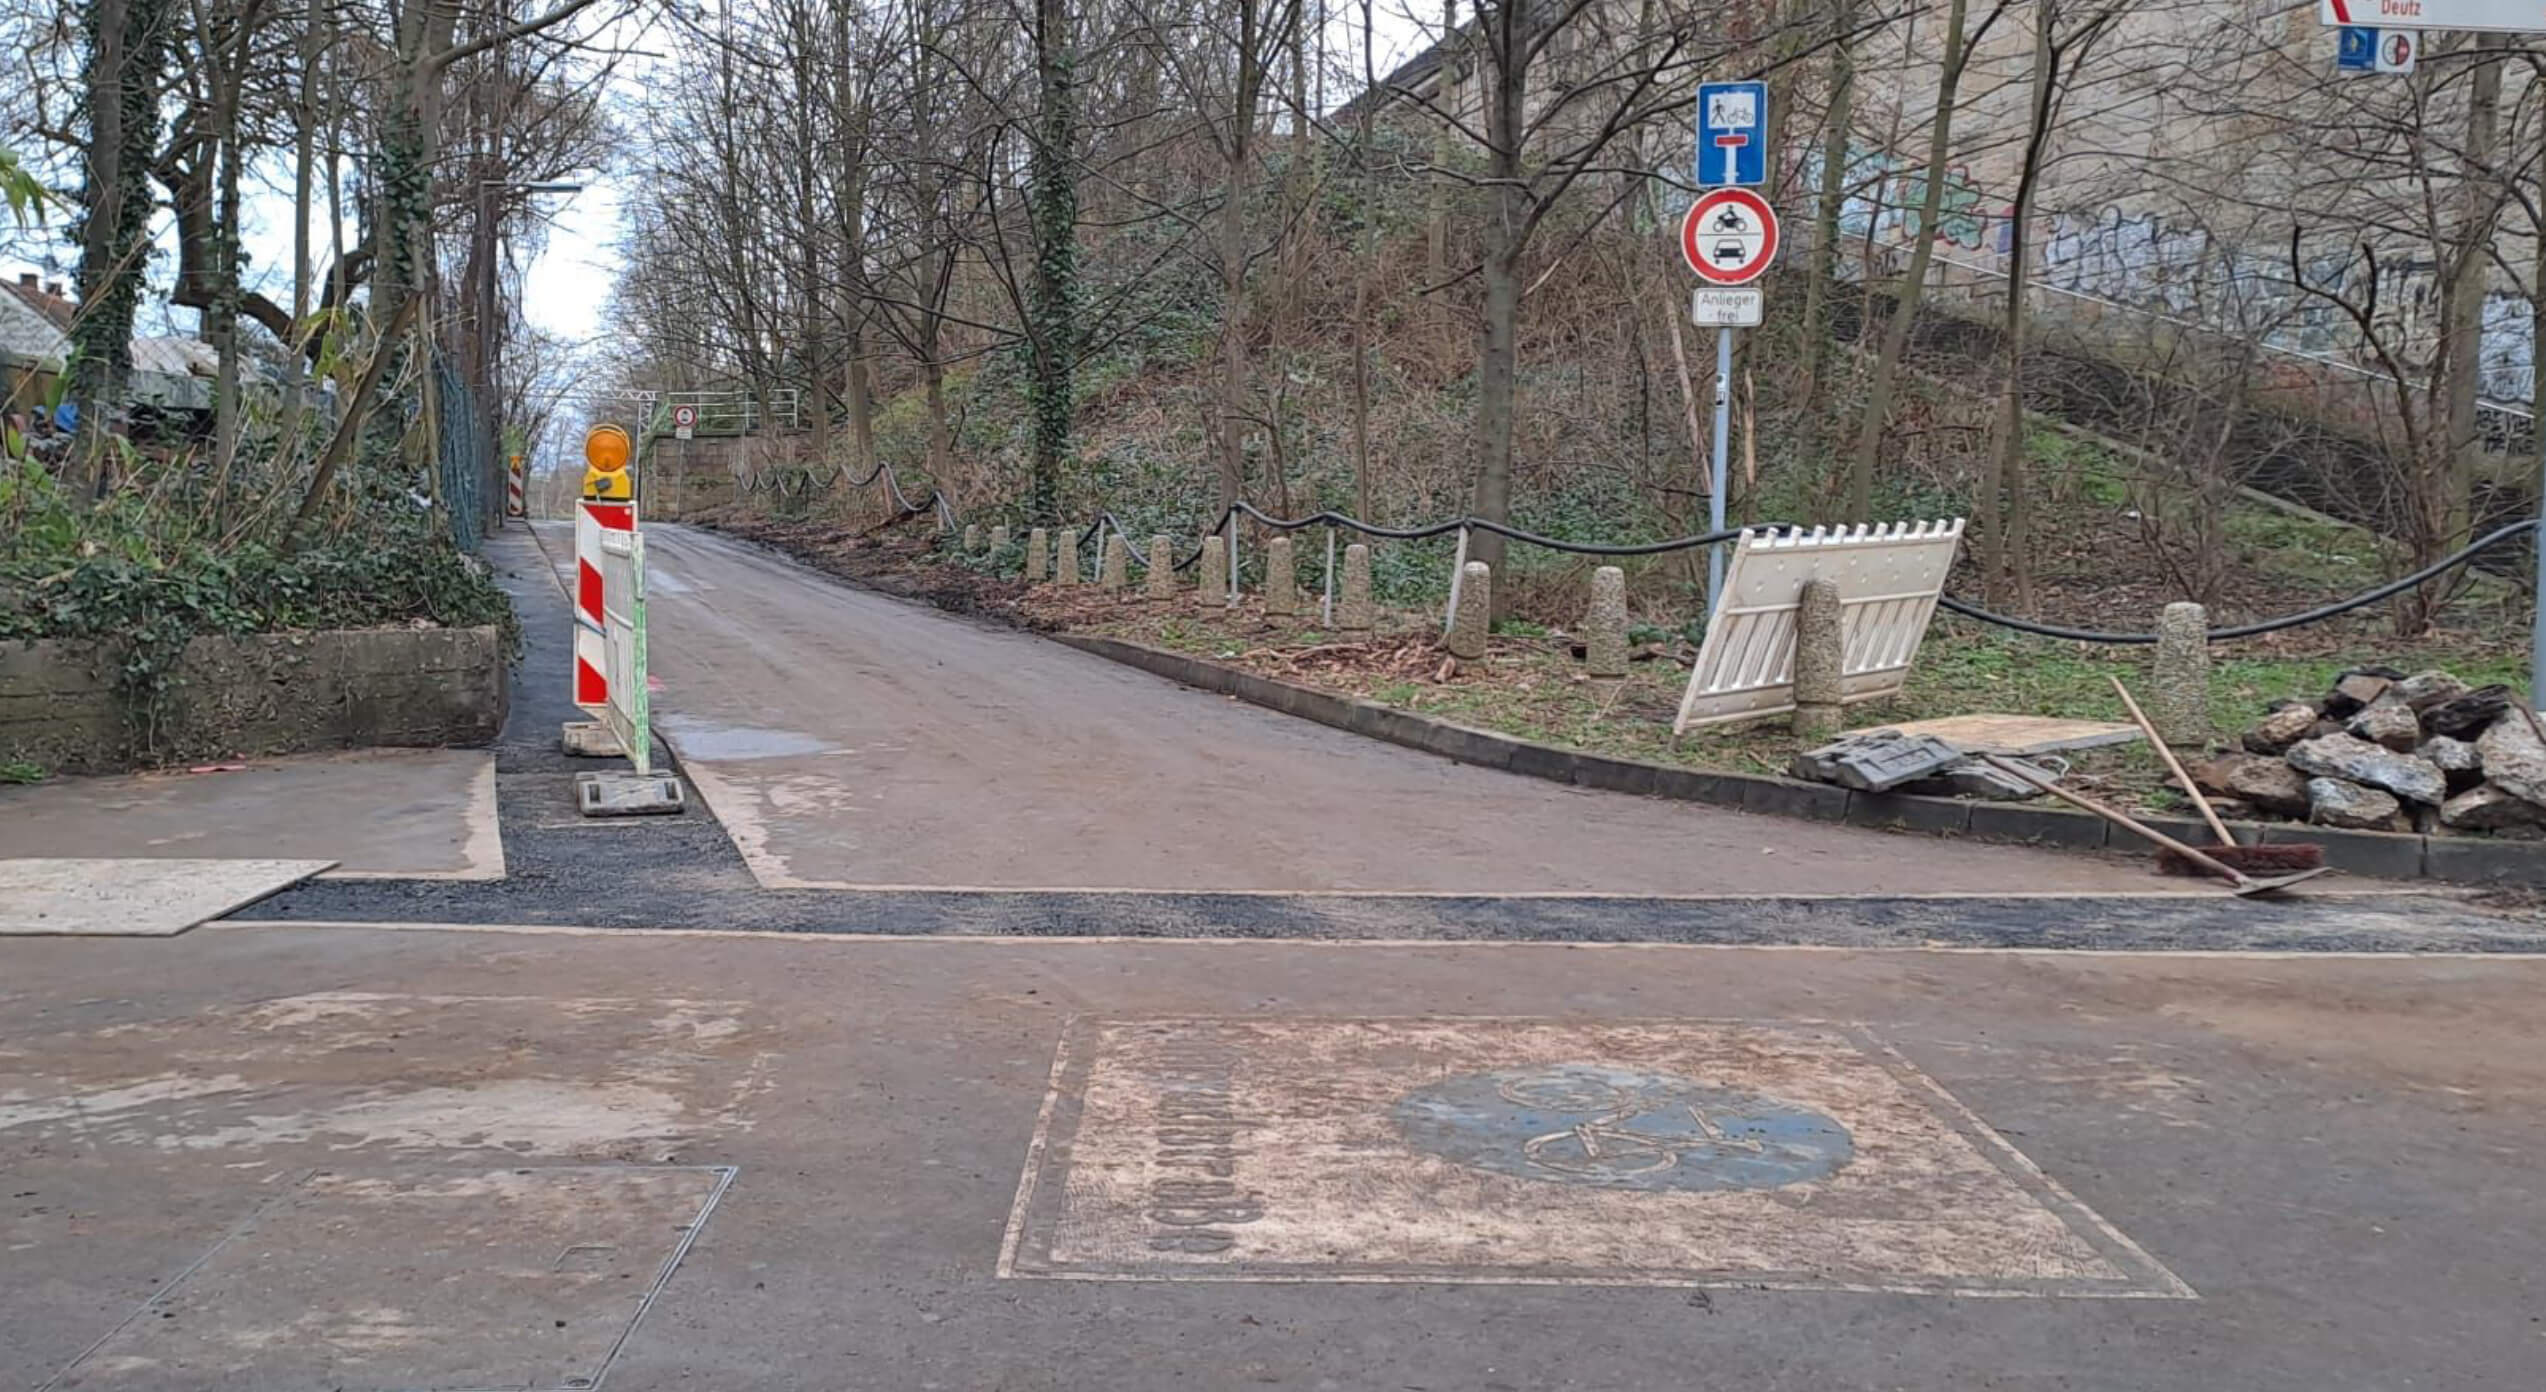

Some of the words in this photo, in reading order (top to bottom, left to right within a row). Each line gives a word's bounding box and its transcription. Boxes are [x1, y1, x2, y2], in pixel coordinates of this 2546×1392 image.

[2381, 0, 2422, 16] Deutz
[1700, 293, 1756, 309] Anlieger
[1718, 308, 1739, 321] frei
[1149, 1025, 1266, 1254] hrradstraße
